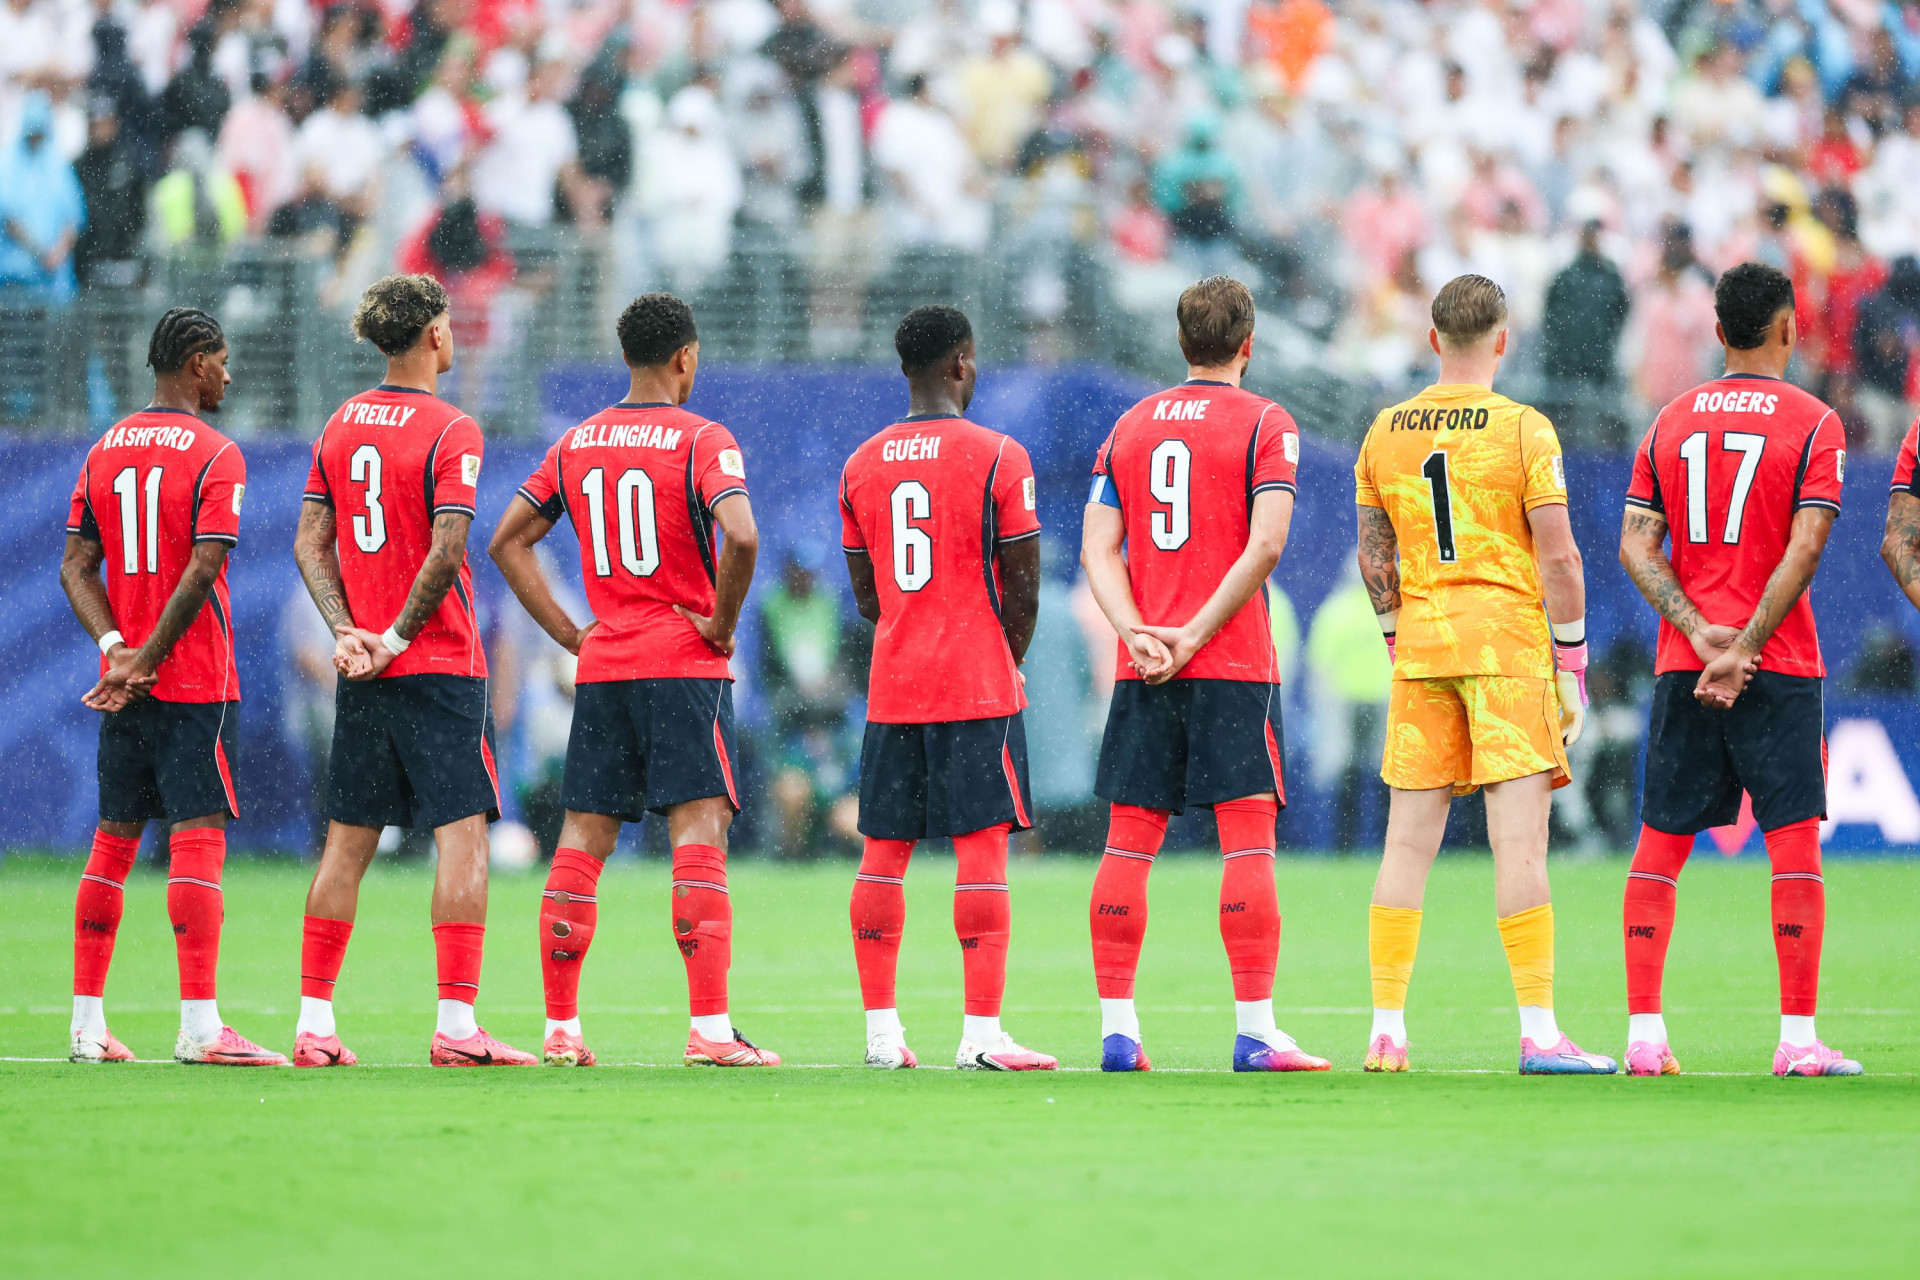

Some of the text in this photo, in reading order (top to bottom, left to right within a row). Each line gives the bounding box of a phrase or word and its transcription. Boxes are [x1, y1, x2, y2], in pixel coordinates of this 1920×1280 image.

[343, 402, 416, 427] O'REILLY
[1152, 400, 1211, 420] KANE
[1692, 391, 1779, 416] ROGERS
[1390, 408, 1489, 432] PICKFORD
[103, 426, 196, 451] RASHFORD
[570, 425, 682, 450] BELLINGHAM
[882, 433, 941, 462] GUÉHI
[350, 444, 388, 554] 3
[1149, 439, 1192, 551] 9
[1679, 431, 1767, 545] 17
[1421, 450, 1457, 563] 1
[113, 465, 164, 575] 11
[581, 467, 661, 577] 10
[890, 480, 932, 593] 6
[1098, 904, 1130, 917] ENG
[1220, 902, 1246, 914] ENG
[82, 919, 109, 933] ENG
[858, 928, 883, 941] ENG
[1628, 925, 1656, 939] ENG
[1777, 922, 1803, 938] ENG
